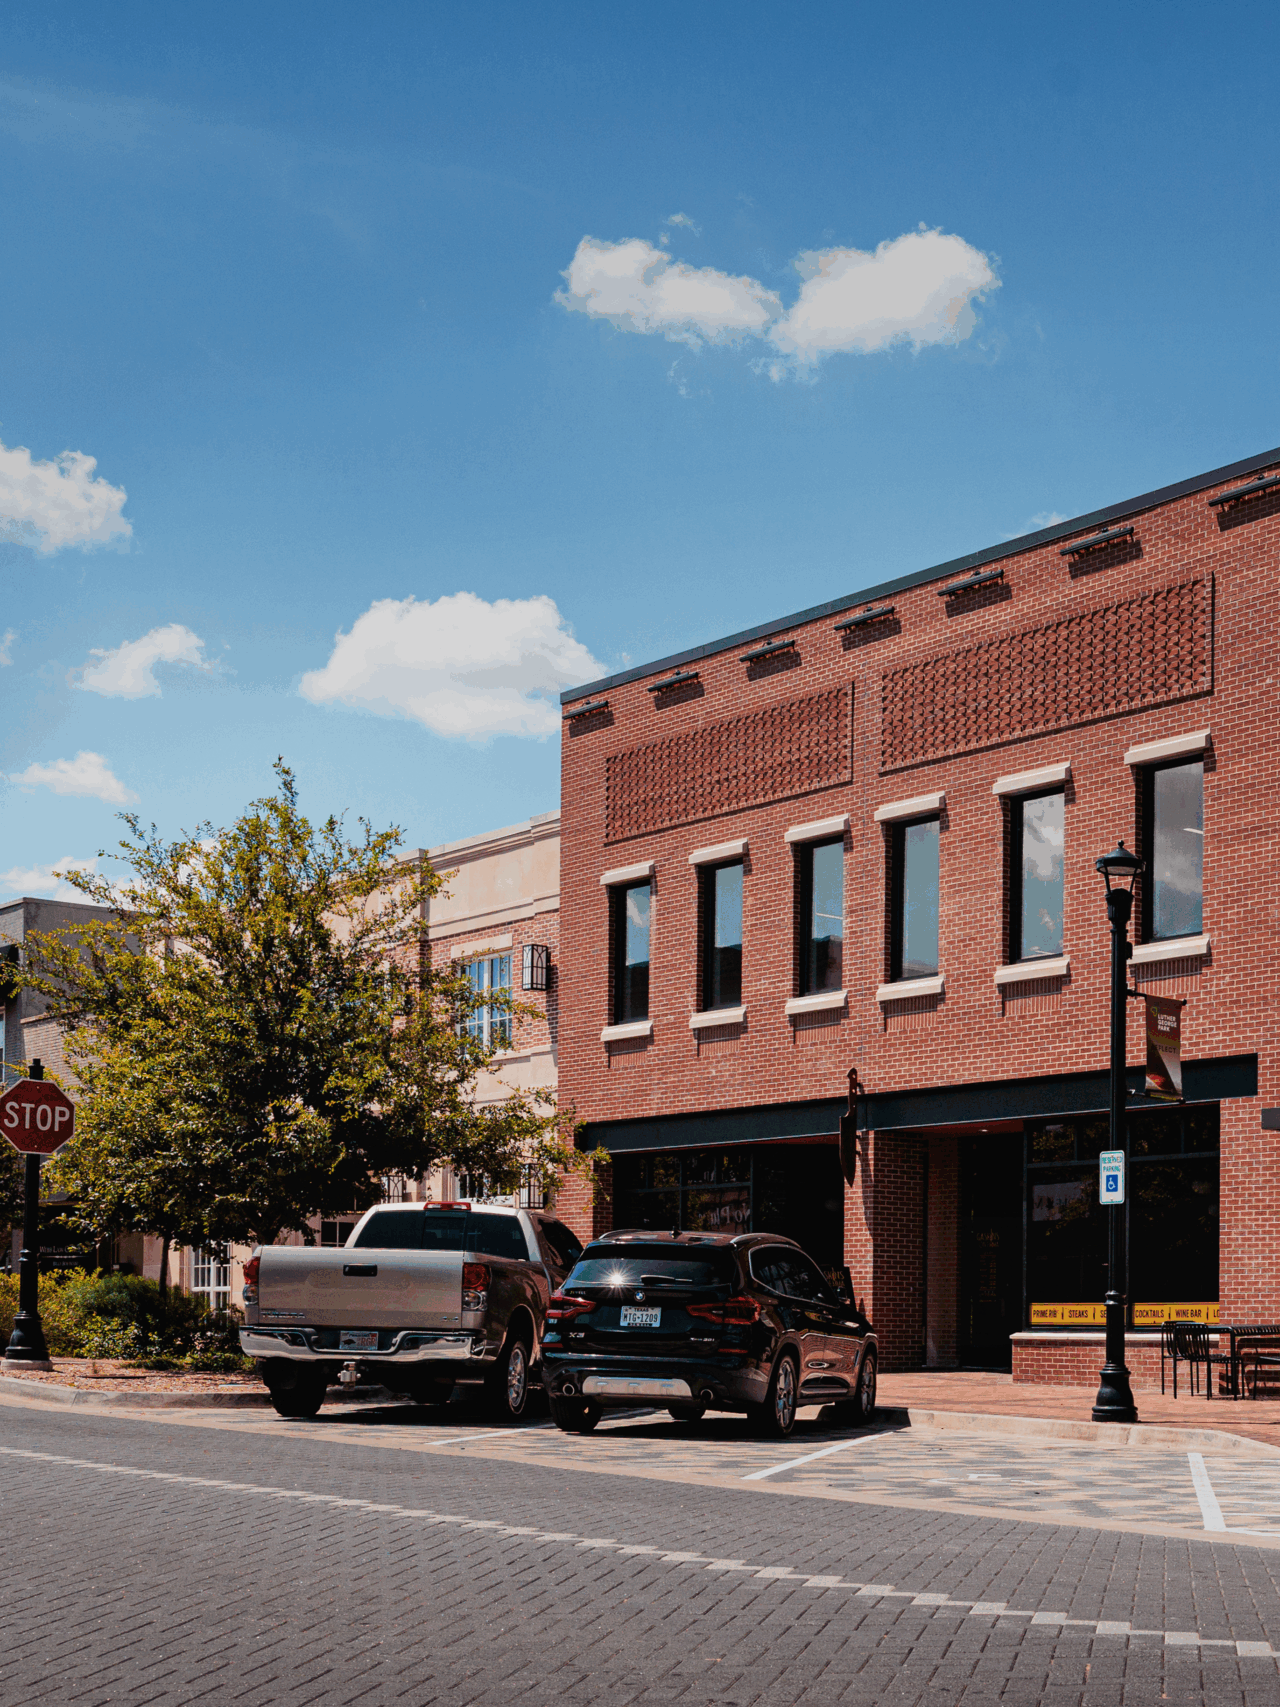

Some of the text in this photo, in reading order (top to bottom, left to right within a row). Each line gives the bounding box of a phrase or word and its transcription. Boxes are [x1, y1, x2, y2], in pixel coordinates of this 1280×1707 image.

[1157, 1013, 1176, 1022] LUTHER
[1157, 1019, 1177, 1028] GEORGE
[3, 1101, 70, 1132] STOP
[1032, 1309, 1058, 1318] PRIME RIB
[1068, 1309, 1089, 1319] STEAKS
[1134, 1309, 1165, 1319] COCKTAILS
[1175, 1308, 1190, 1318] WINE
[1190, 1308, 1202, 1318] BAR
